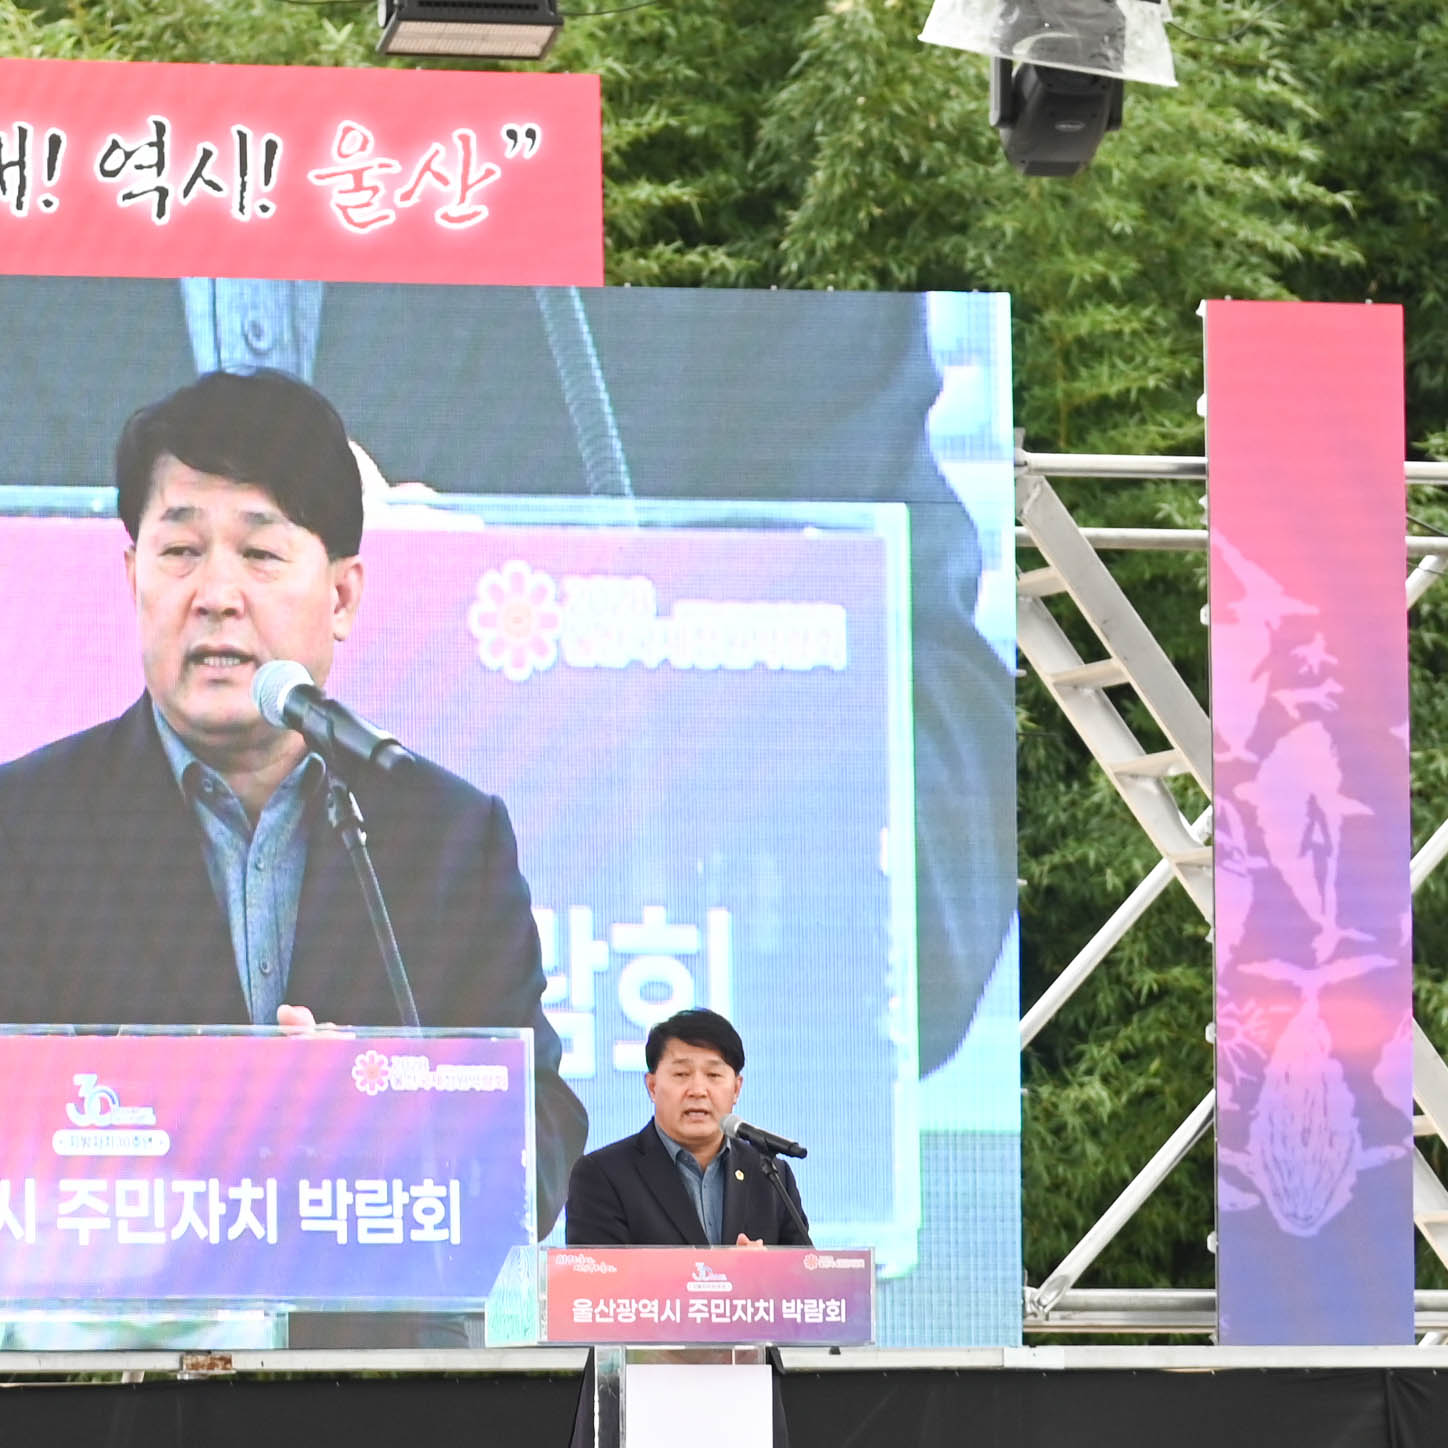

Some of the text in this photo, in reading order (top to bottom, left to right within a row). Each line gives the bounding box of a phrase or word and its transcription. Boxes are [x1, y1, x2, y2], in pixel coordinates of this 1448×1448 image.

[98, 118, 280, 222] 역시!
[56, 1178, 278, 1246] 주민자치
[298, 1178, 461, 1246] 박람회
[572, 1298, 846, 1323] 울산광역시 주민자치 박람회
